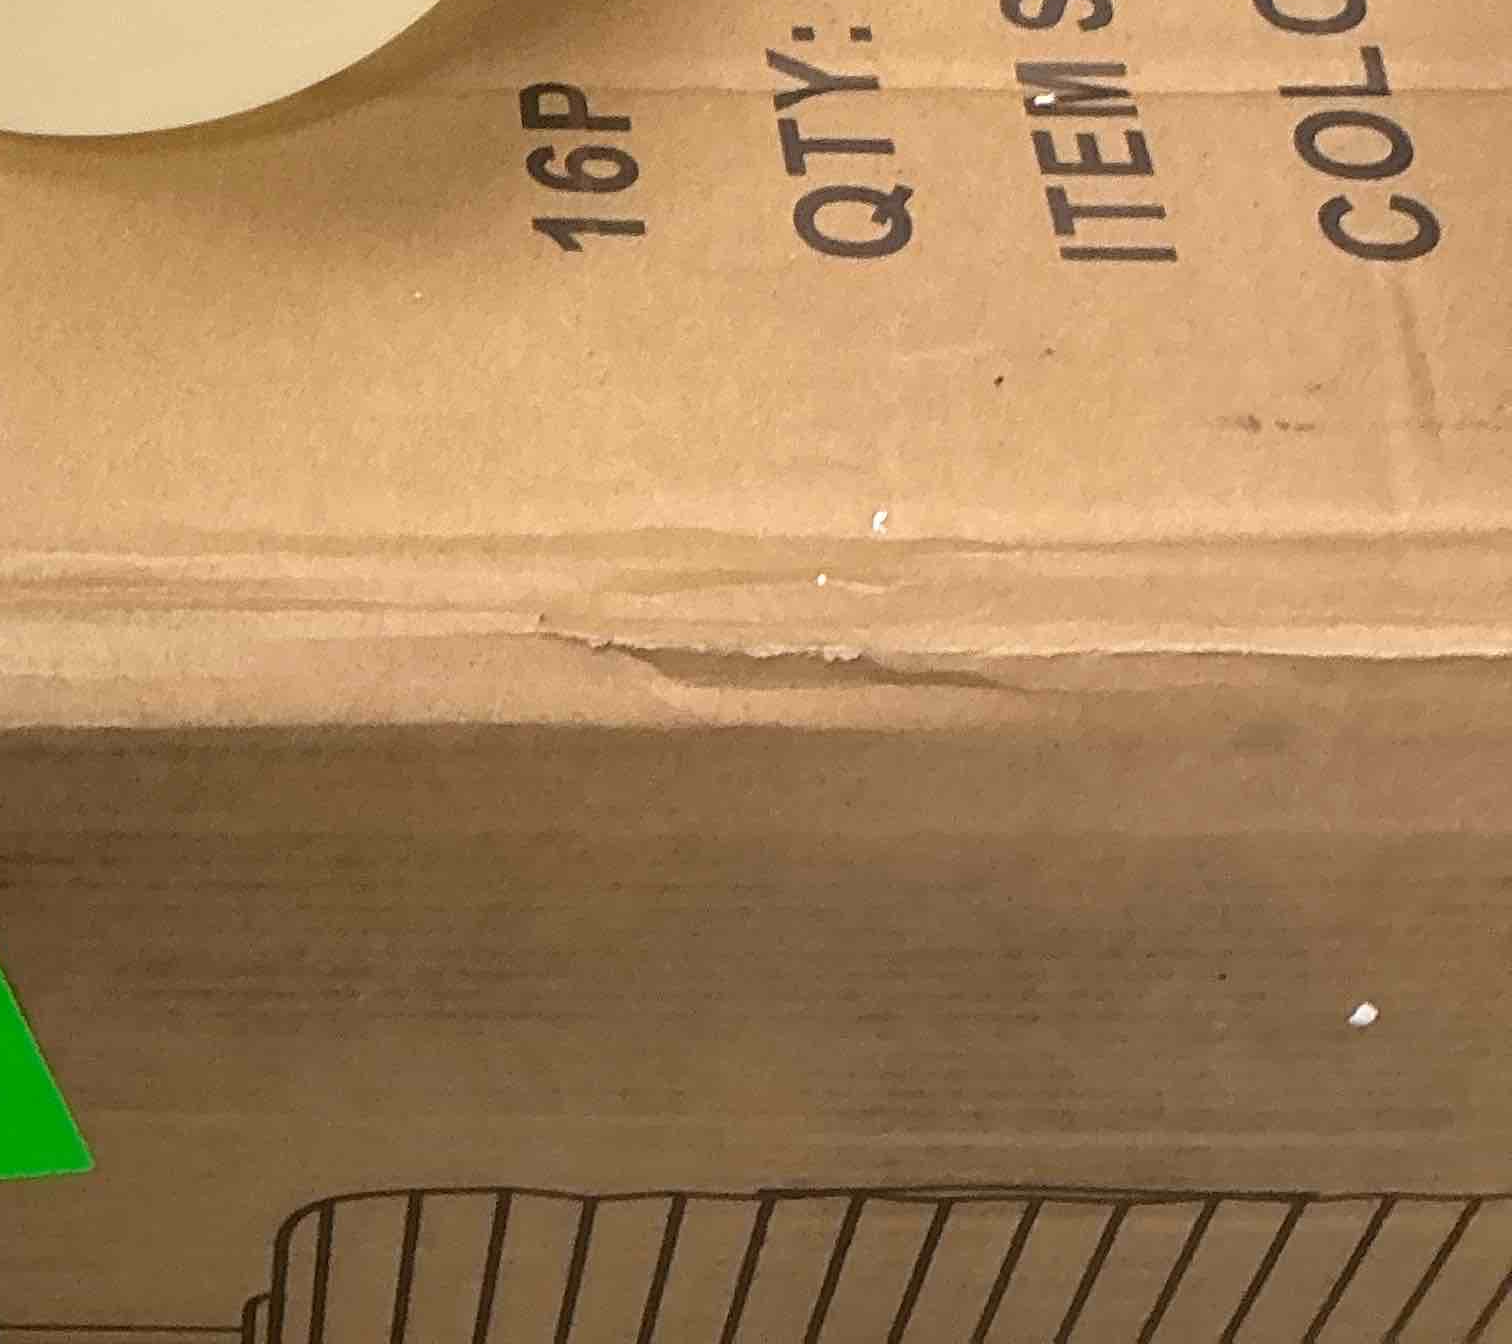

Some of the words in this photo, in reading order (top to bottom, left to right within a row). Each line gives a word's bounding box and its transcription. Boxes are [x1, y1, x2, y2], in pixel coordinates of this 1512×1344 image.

[519, 82, 645, 252] 16P
[767, 23, 916, 260] QTY:
[1015, 62, 1179, 263] ITEM
